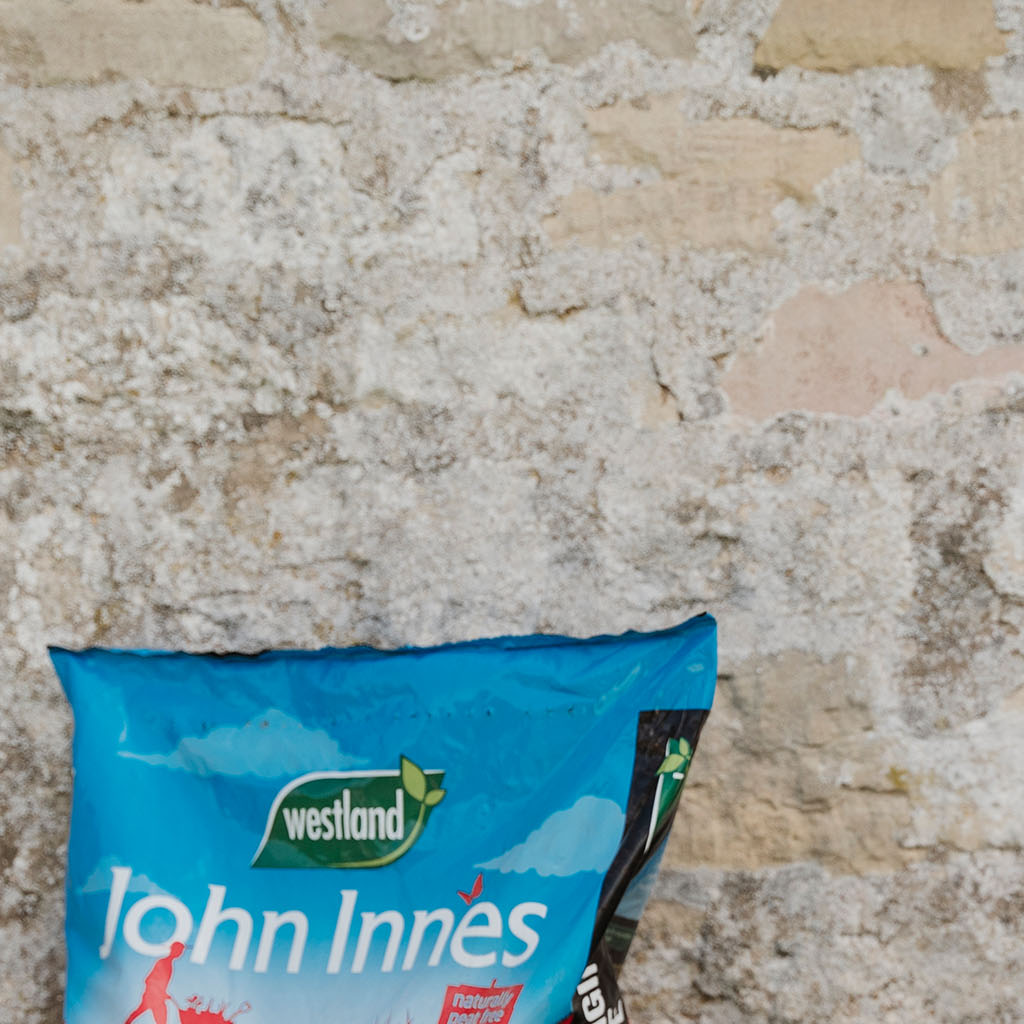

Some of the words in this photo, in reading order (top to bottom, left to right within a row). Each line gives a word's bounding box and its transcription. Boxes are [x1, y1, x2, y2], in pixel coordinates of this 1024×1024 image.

[282, 788, 404, 841] westland
[99, 866, 309, 974] John
[326, 889, 548, 974] Innes
[452, 991, 514, 1009] naturally
[479, 1009, 504, 1024] free
